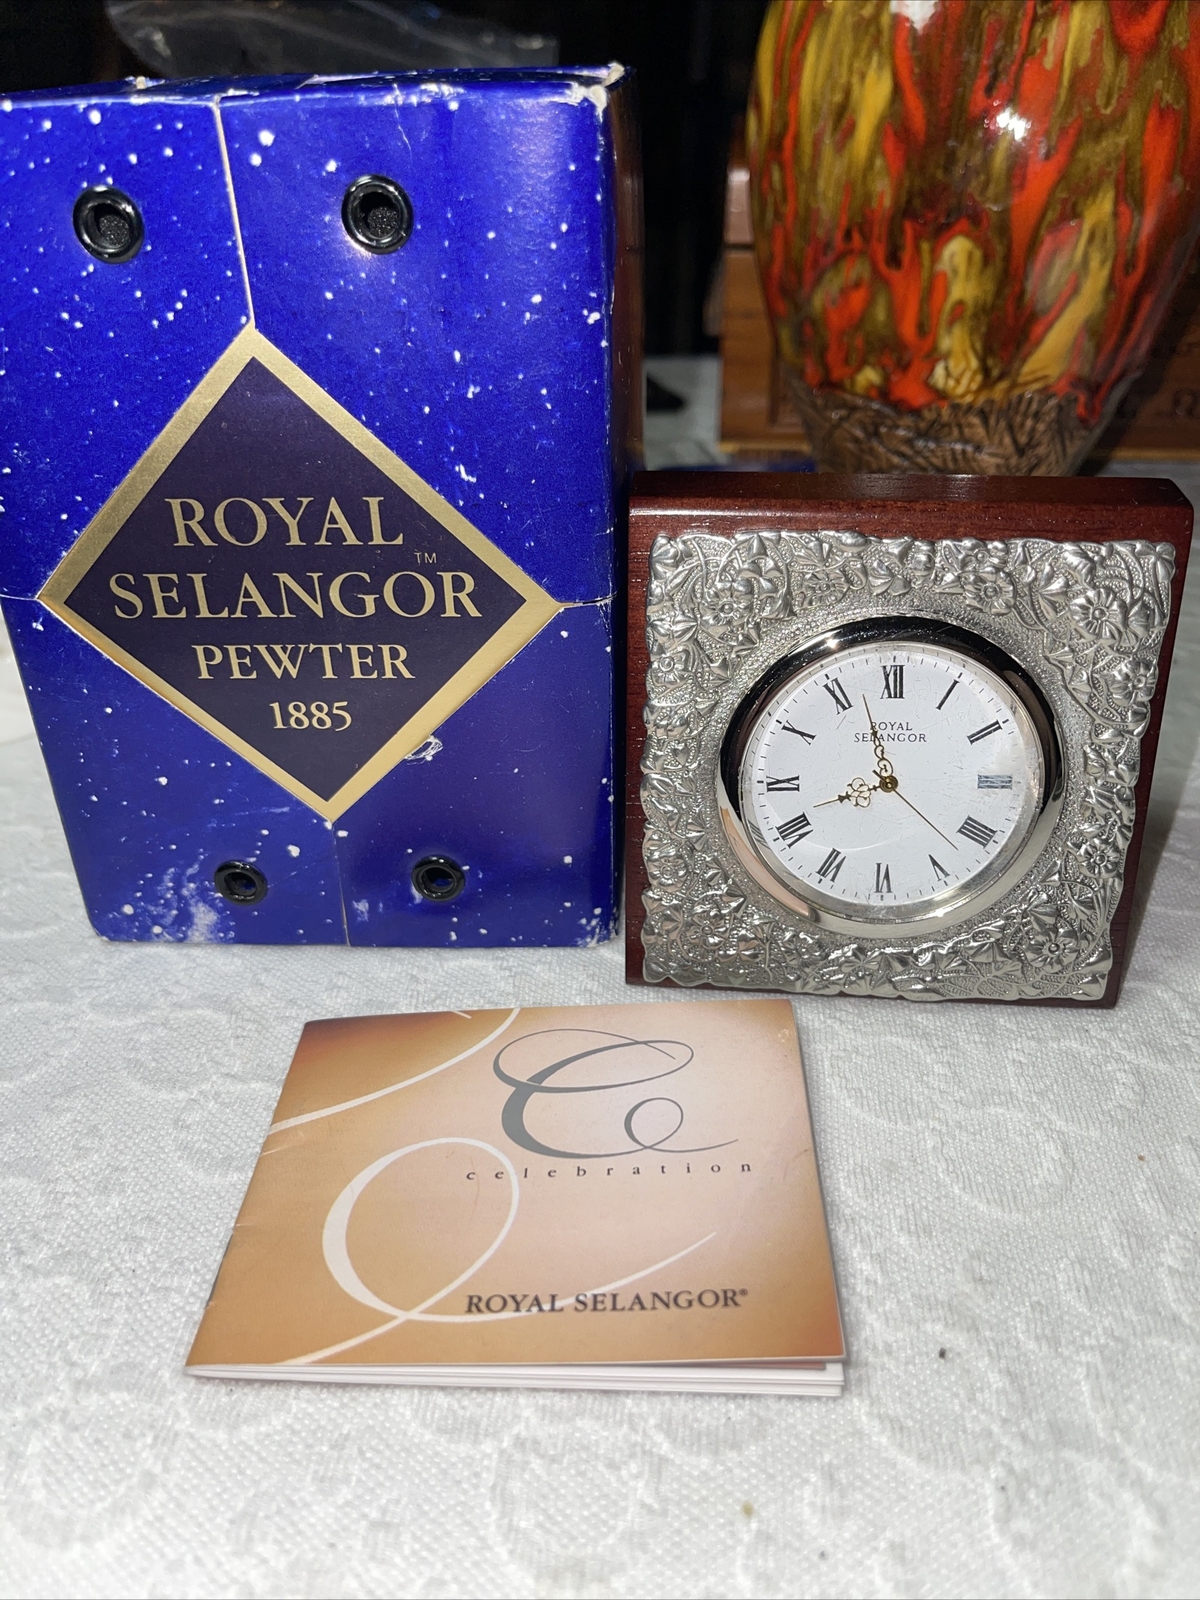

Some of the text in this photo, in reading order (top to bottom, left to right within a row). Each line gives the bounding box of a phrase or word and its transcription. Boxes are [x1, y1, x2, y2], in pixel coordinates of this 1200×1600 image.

[164, 496, 404, 547] ROYAL
[108, 571, 483, 620] SELANGOR
[191, 642, 416, 680] PEWTER
[822, 677, 854, 715] XI
[880, 664, 905, 700] XII
[268, 701, 353, 732] 1885
[781, 720, 816, 745] X
[870, 721, 913, 731] ROYAL
[766, 775, 800, 792] IX
[775, 811, 814, 849] VIII
[816, 847, 847, 883] VII
[874, 862, 893, 894] VI
[928, 853, 950, 882] V
[466, 1161, 752, 1181] celebration
[465, 1293, 565, 1314] ROYAL
